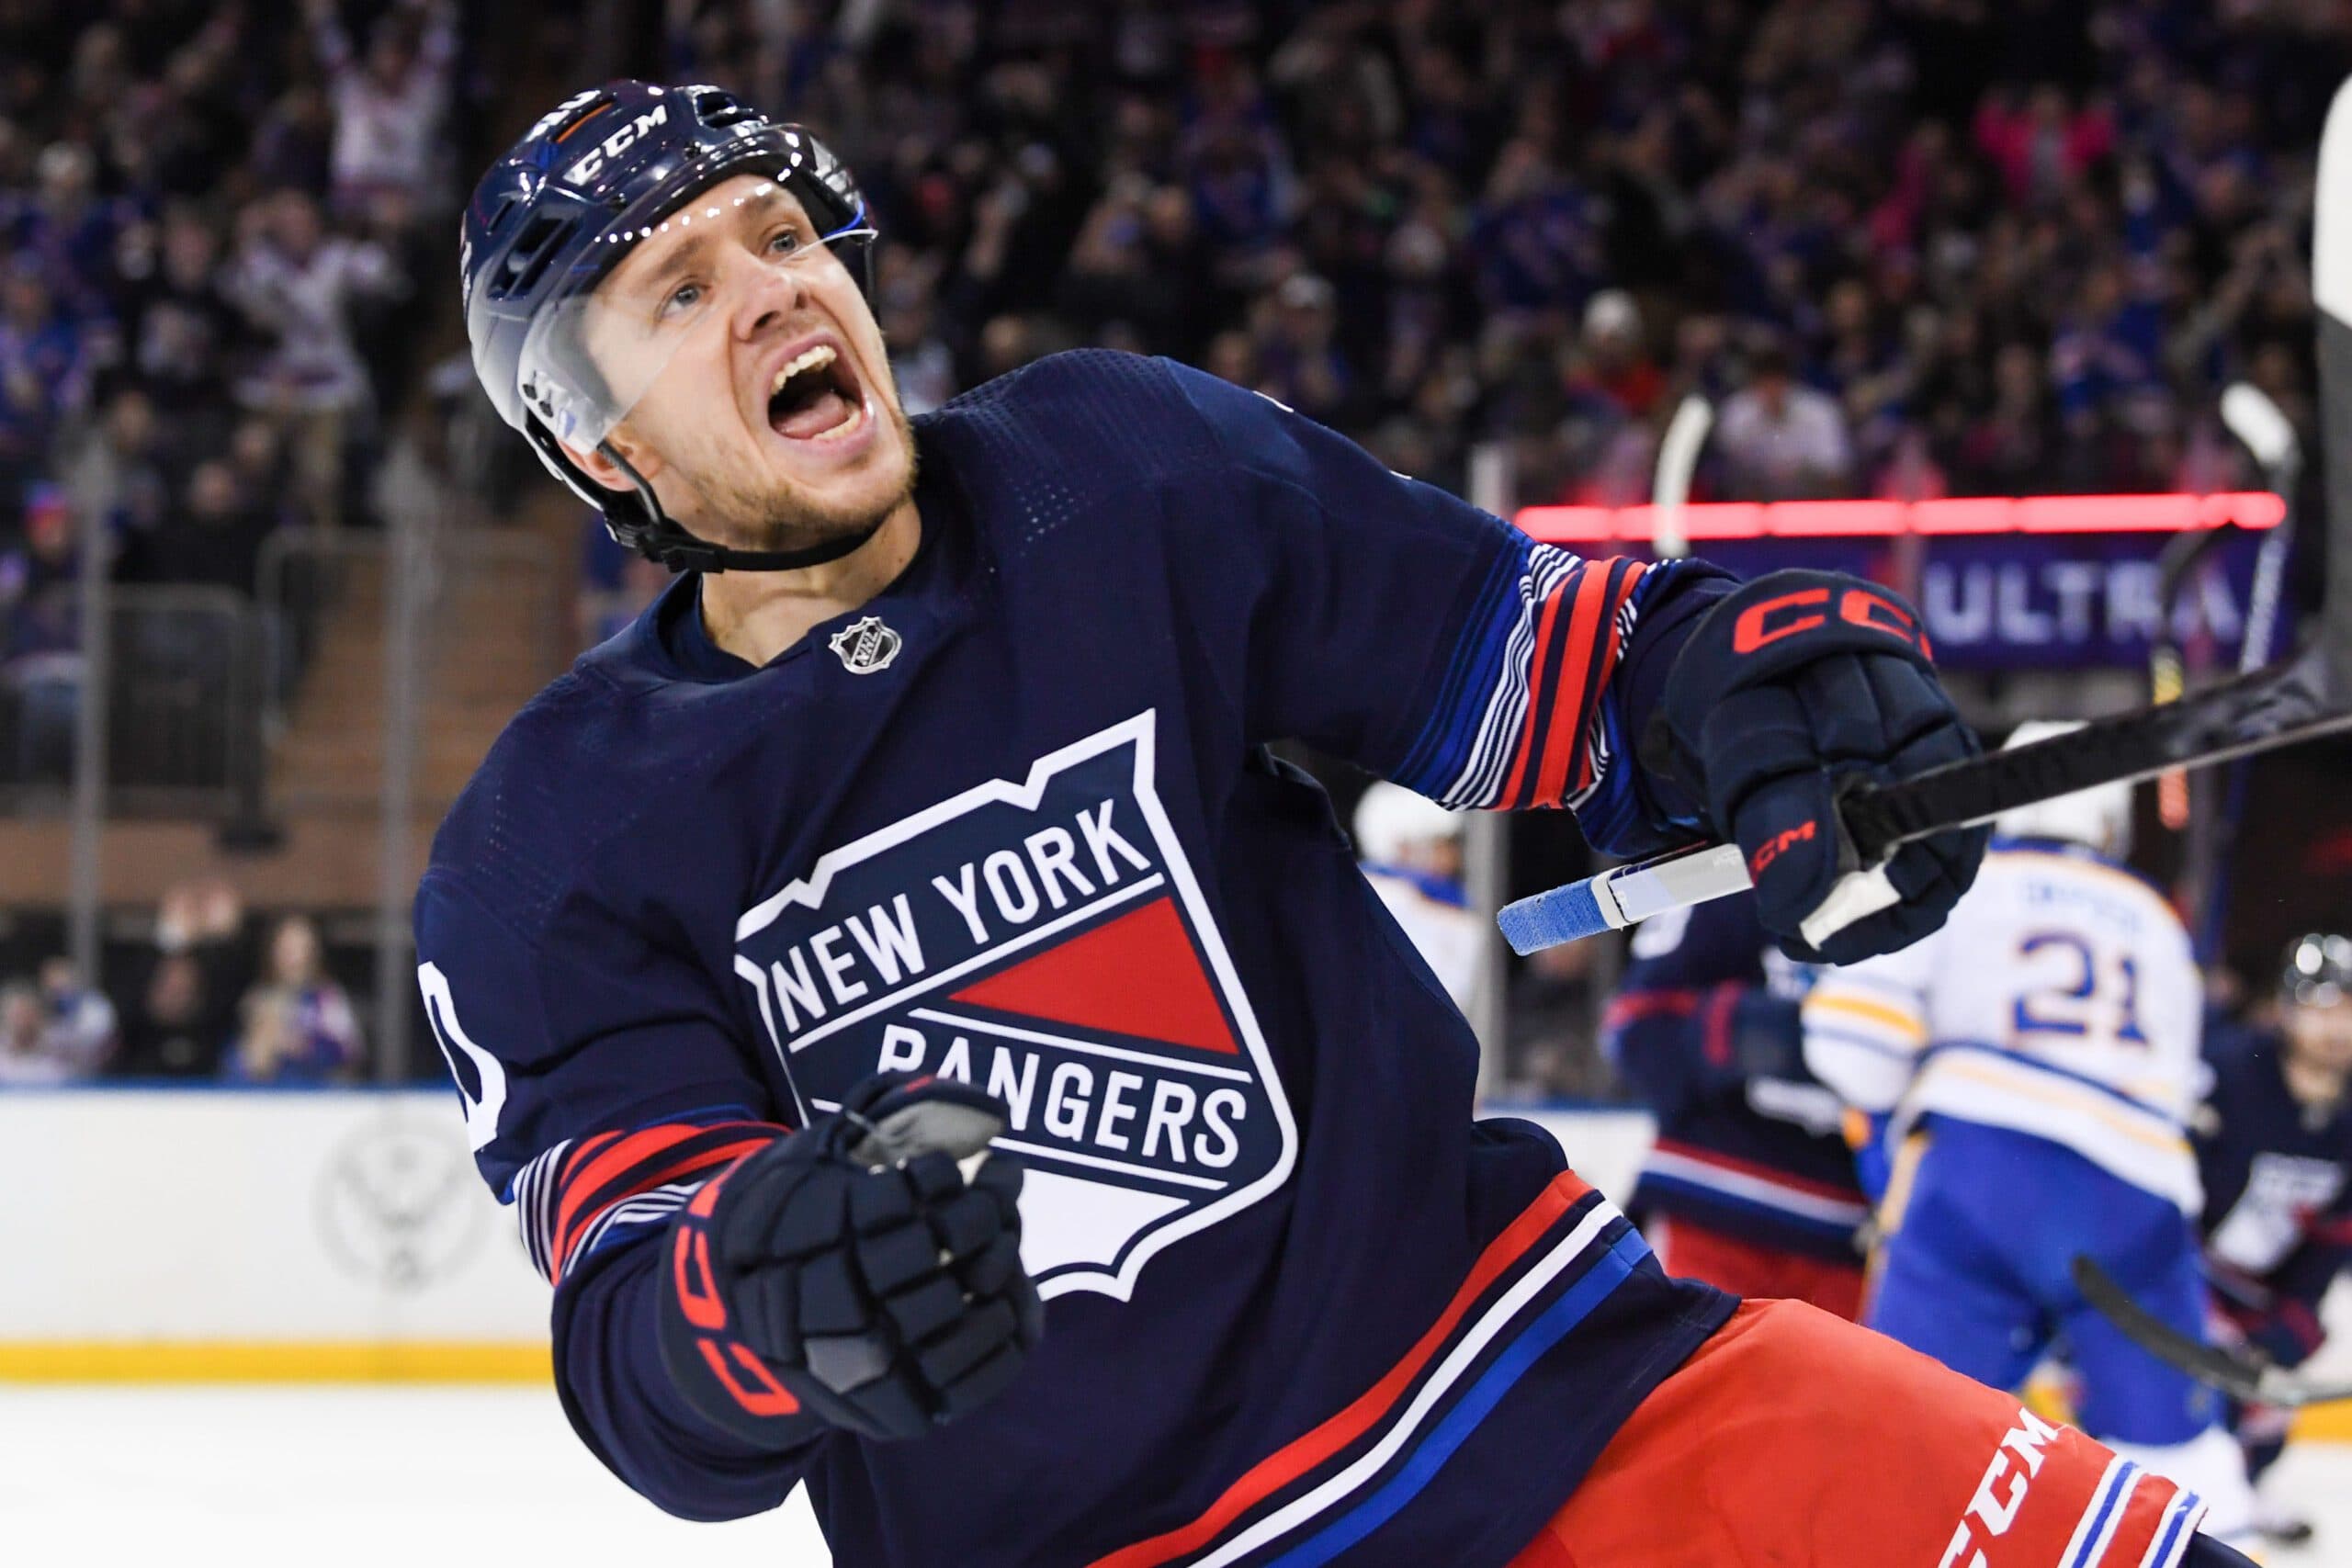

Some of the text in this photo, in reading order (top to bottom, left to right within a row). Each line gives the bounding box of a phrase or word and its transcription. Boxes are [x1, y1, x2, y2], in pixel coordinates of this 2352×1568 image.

[562, 104, 668, 186] CCM
[1926, 558, 2243, 644] ULTRA
[771, 797, 1152, 1034] NEW YORK
[2012, 927, 2150, 1045] 21
